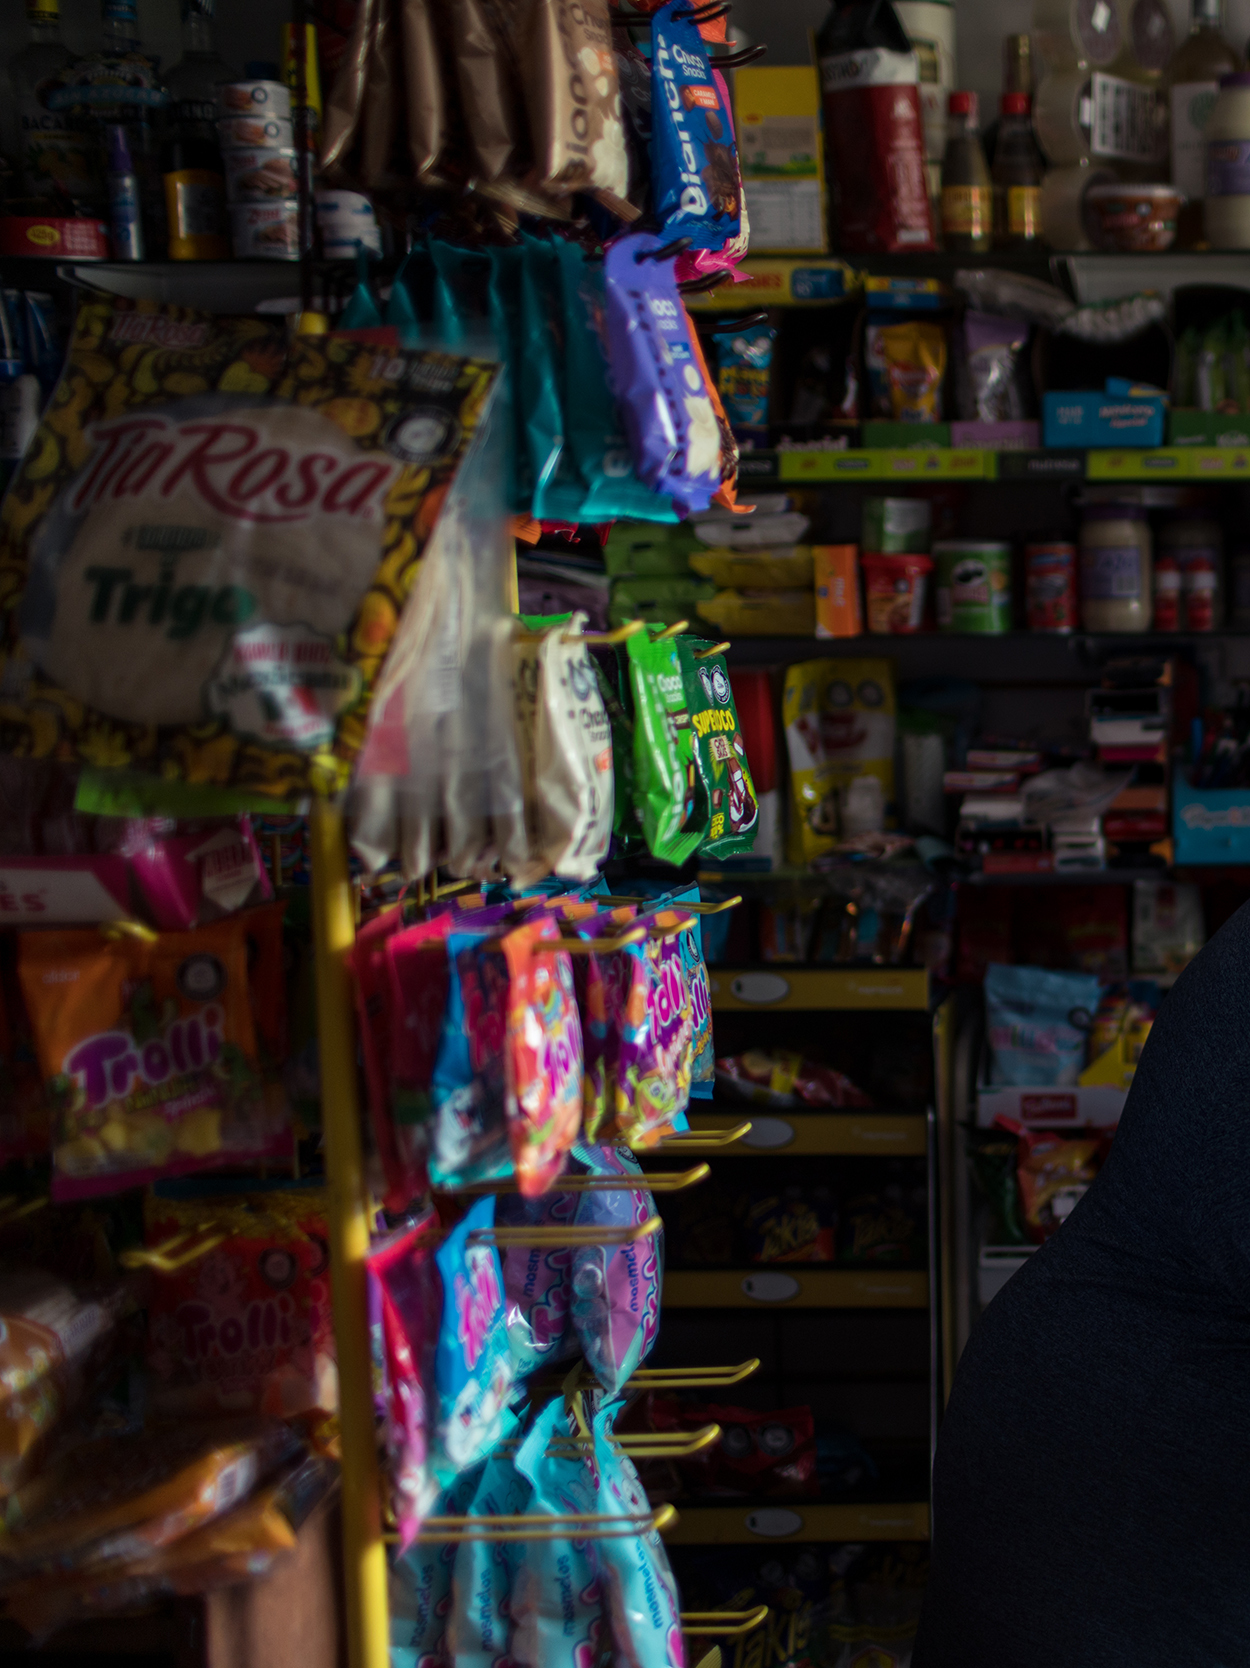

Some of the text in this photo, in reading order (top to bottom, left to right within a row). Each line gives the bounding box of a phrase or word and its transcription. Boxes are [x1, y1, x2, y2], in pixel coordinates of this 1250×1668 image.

[85, 565, 256, 640] Trigo
[63, 1003, 225, 1107] Trolli
[176, 1290, 295, 1364] Trolli
